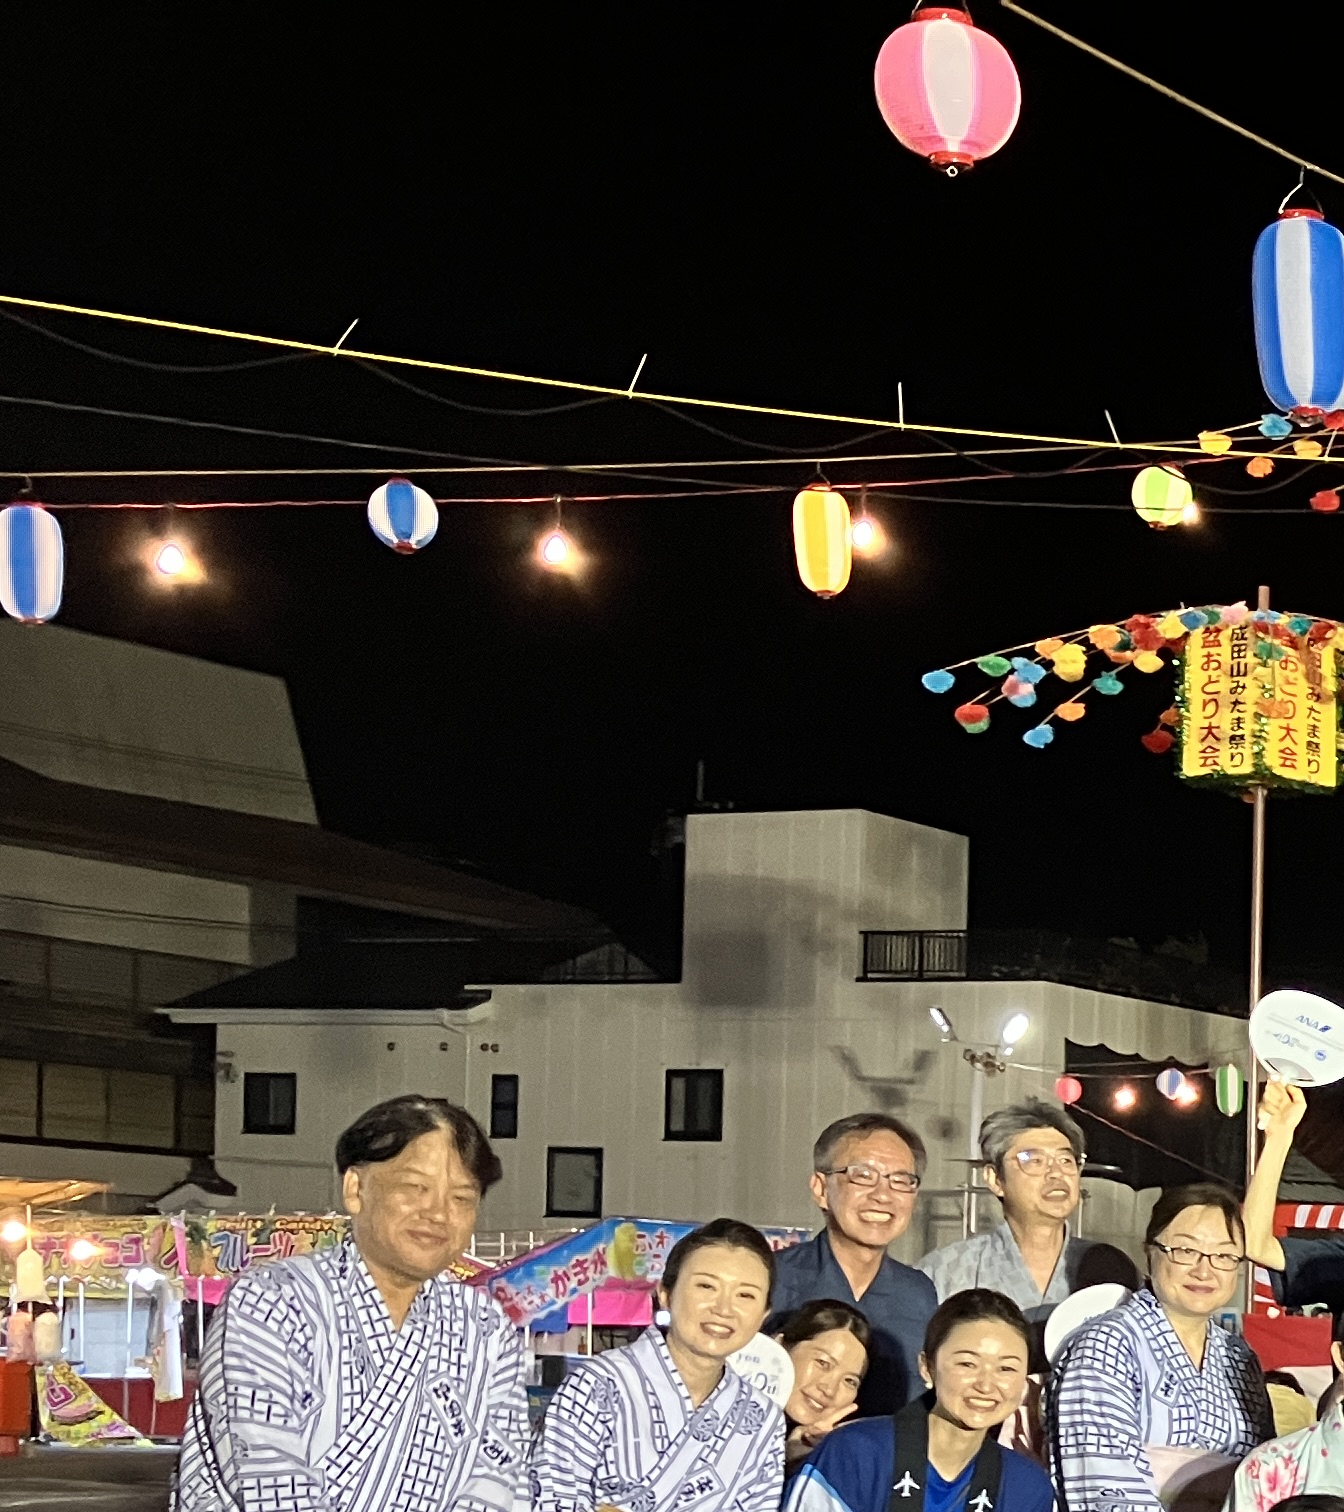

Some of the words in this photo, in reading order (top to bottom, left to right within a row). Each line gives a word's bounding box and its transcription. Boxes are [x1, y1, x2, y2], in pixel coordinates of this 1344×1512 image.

[1198, 628, 1223, 769] 盆おどり大会
[1228, 625, 1249, 768] 成田山みたま祭り
